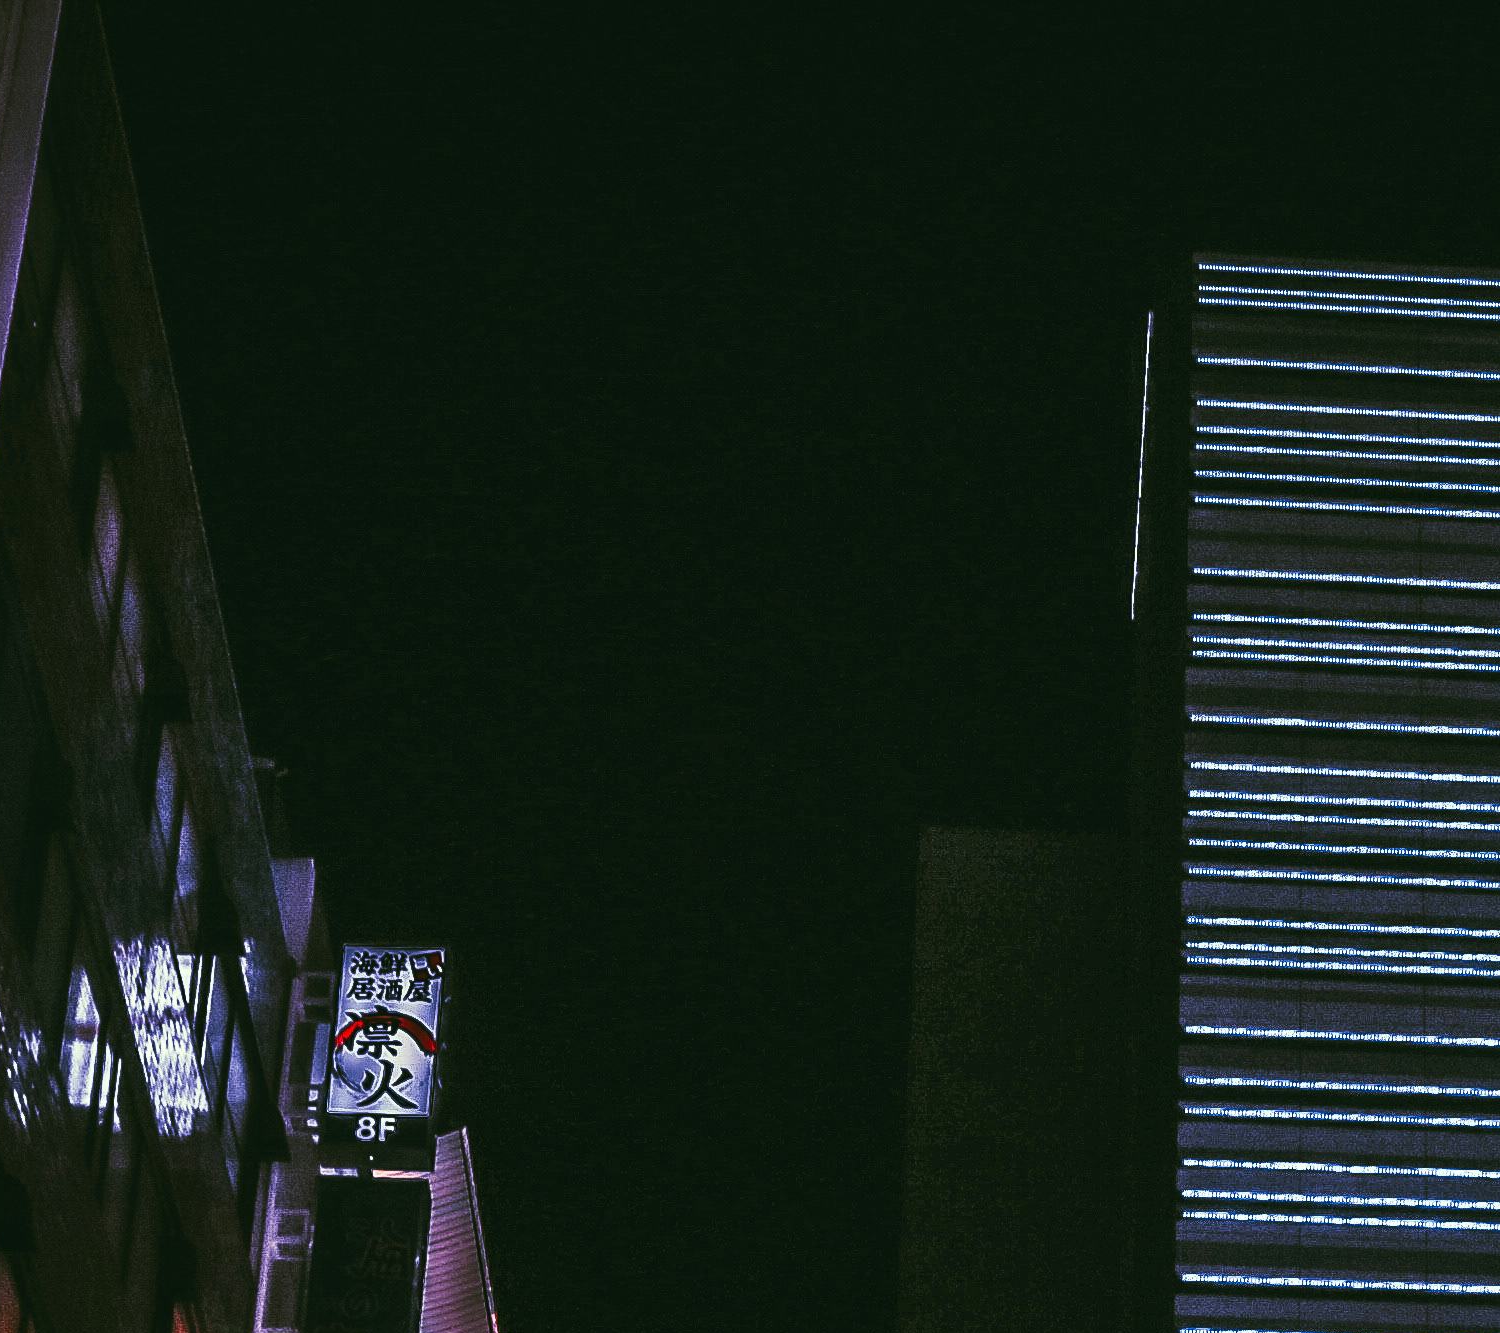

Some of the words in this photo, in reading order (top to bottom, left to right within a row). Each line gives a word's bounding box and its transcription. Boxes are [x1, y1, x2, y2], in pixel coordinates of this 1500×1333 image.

[349, 951, 408, 977] 海鮮
[347, 978, 433, 1004] 居酒屋
[354, 1116, 397, 1142] 8F
